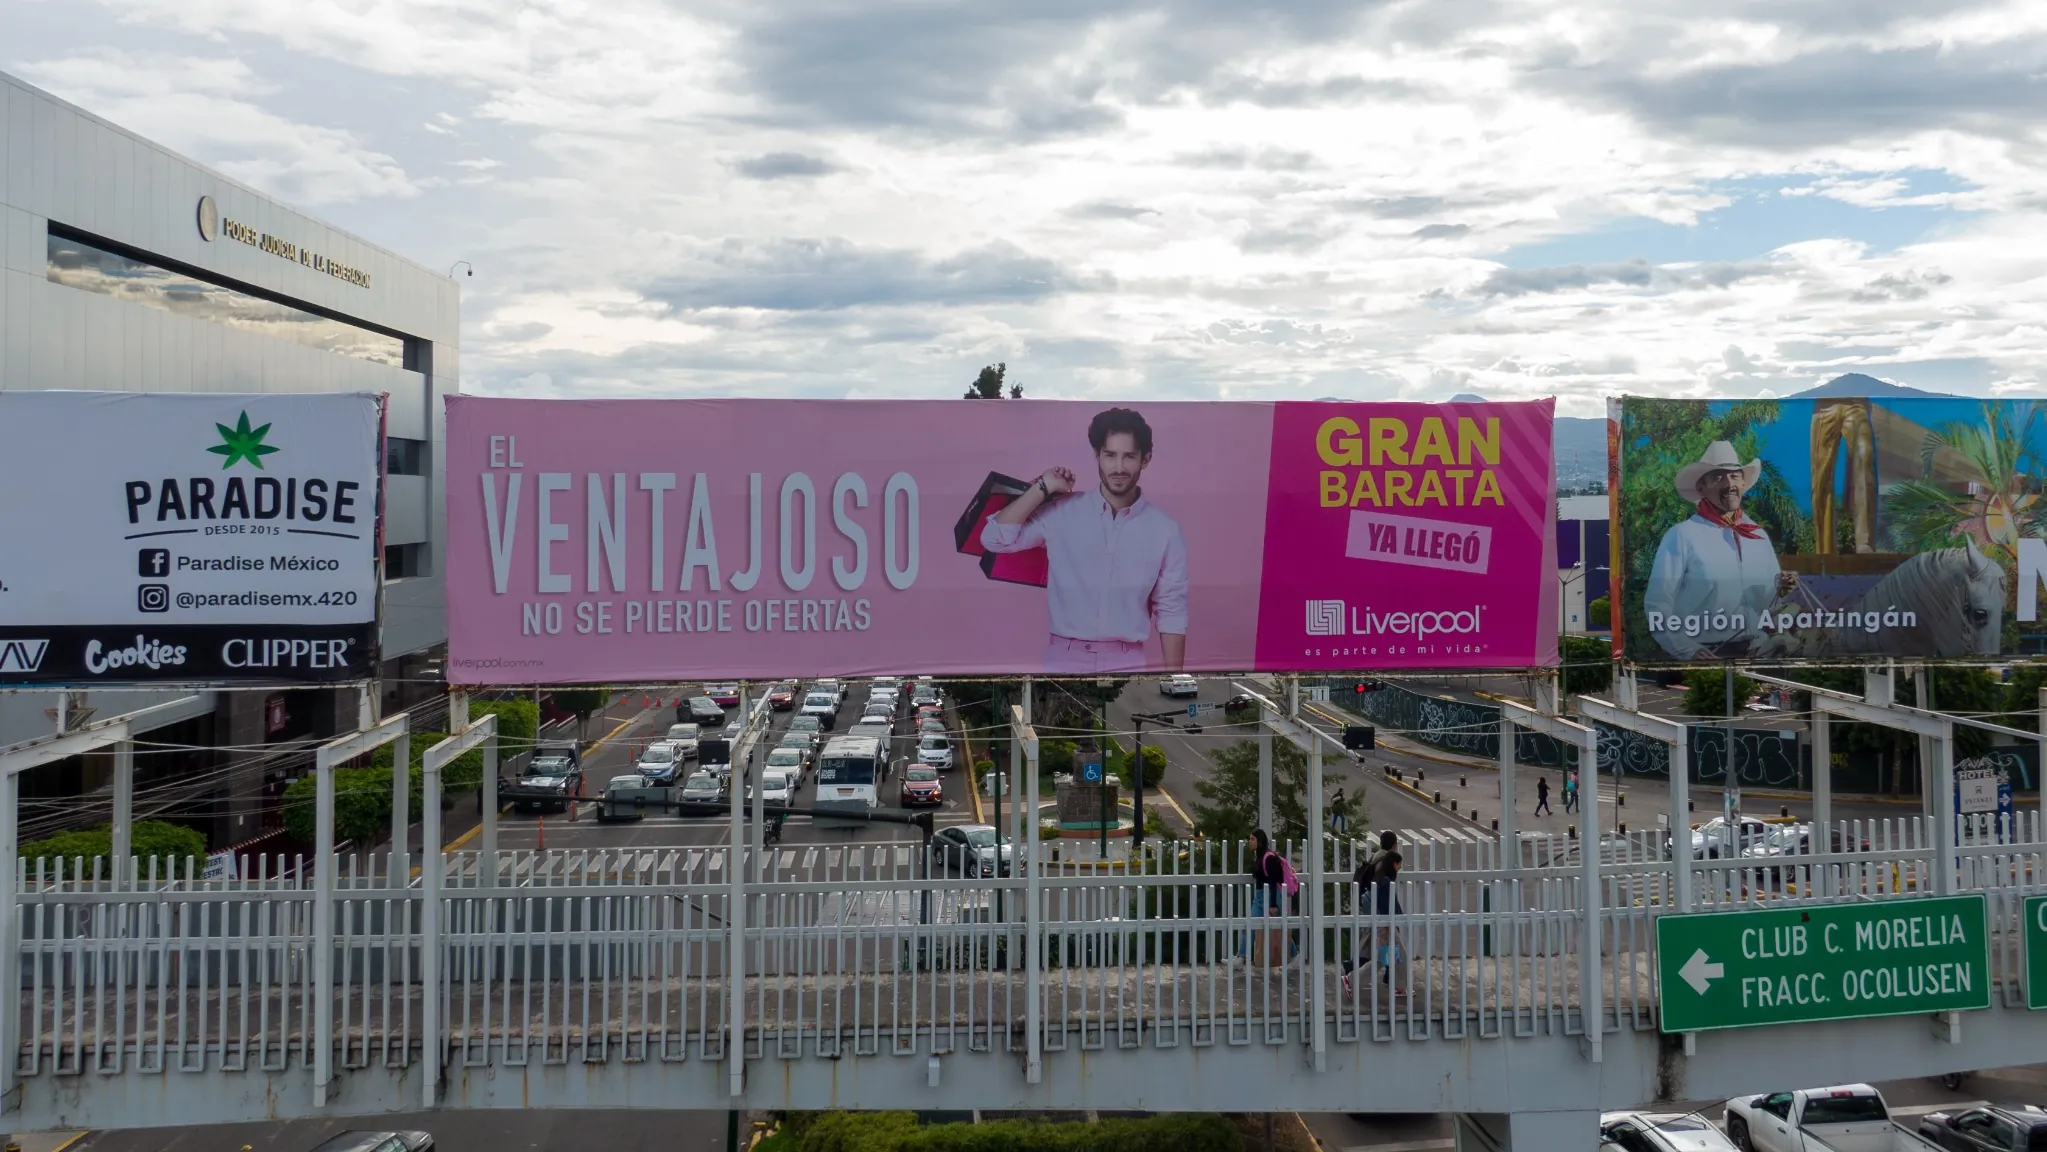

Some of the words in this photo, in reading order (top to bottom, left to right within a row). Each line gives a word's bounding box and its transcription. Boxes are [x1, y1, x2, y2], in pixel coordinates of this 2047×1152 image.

[223, 217, 257, 247] PODER
[259, 233, 298, 262] JUDICIAL
[300, 248, 313, 268] DE
[313, 254, 325, 272] LA
[490, 435, 524, 467] EL
[1316, 416, 1500, 466] GRAN
[125, 477, 359, 524] PARADISE
[1319, 469, 1505, 507] BARATA
[205, 525, 246, 536] DESDE
[250, 525, 280, 536] 2015
[481, 471, 920, 594] VENTAJOSO
[1368, 522, 1398, 554] YA
[1403, 526, 1481, 564] LLEGÓ
[177, 555, 265, 572] Paradise
[270, 555, 339, 572] México
[176, 591, 357, 609] @paradisemx.420
[523, 602, 562, 635] NO
[576, 601, 612, 634] SE
[626, 599, 732, 633] PIERDE
[745, 598, 871, 631] OFERTAS
[1648, 608, 1745, 637] Región
[1757, 604, 1917, 635] Apatzingán
[85, 634, 187, 673] Cookies
[452, 656, 545, 671] liverpool.com.mx
[1305, 648, 1320, 656] es
[1332, 646, 1377, 657] parte
[1388, 645, 1406, 654] de
[1417, 645, 1435, 654] mi
[1446, 644, 1481, 654] vida
[1960, 769, 1997, 779] HOTEL
[1741, 925, 1808, 959] CLUB
[1824, 922, 1844, 954] C.
[1855, 914, 1966, 952] MORELIA
[1742, 973, 1831, 1008] FRACC.
[1842, 962, 1972, 1001] OCOLUSEN
